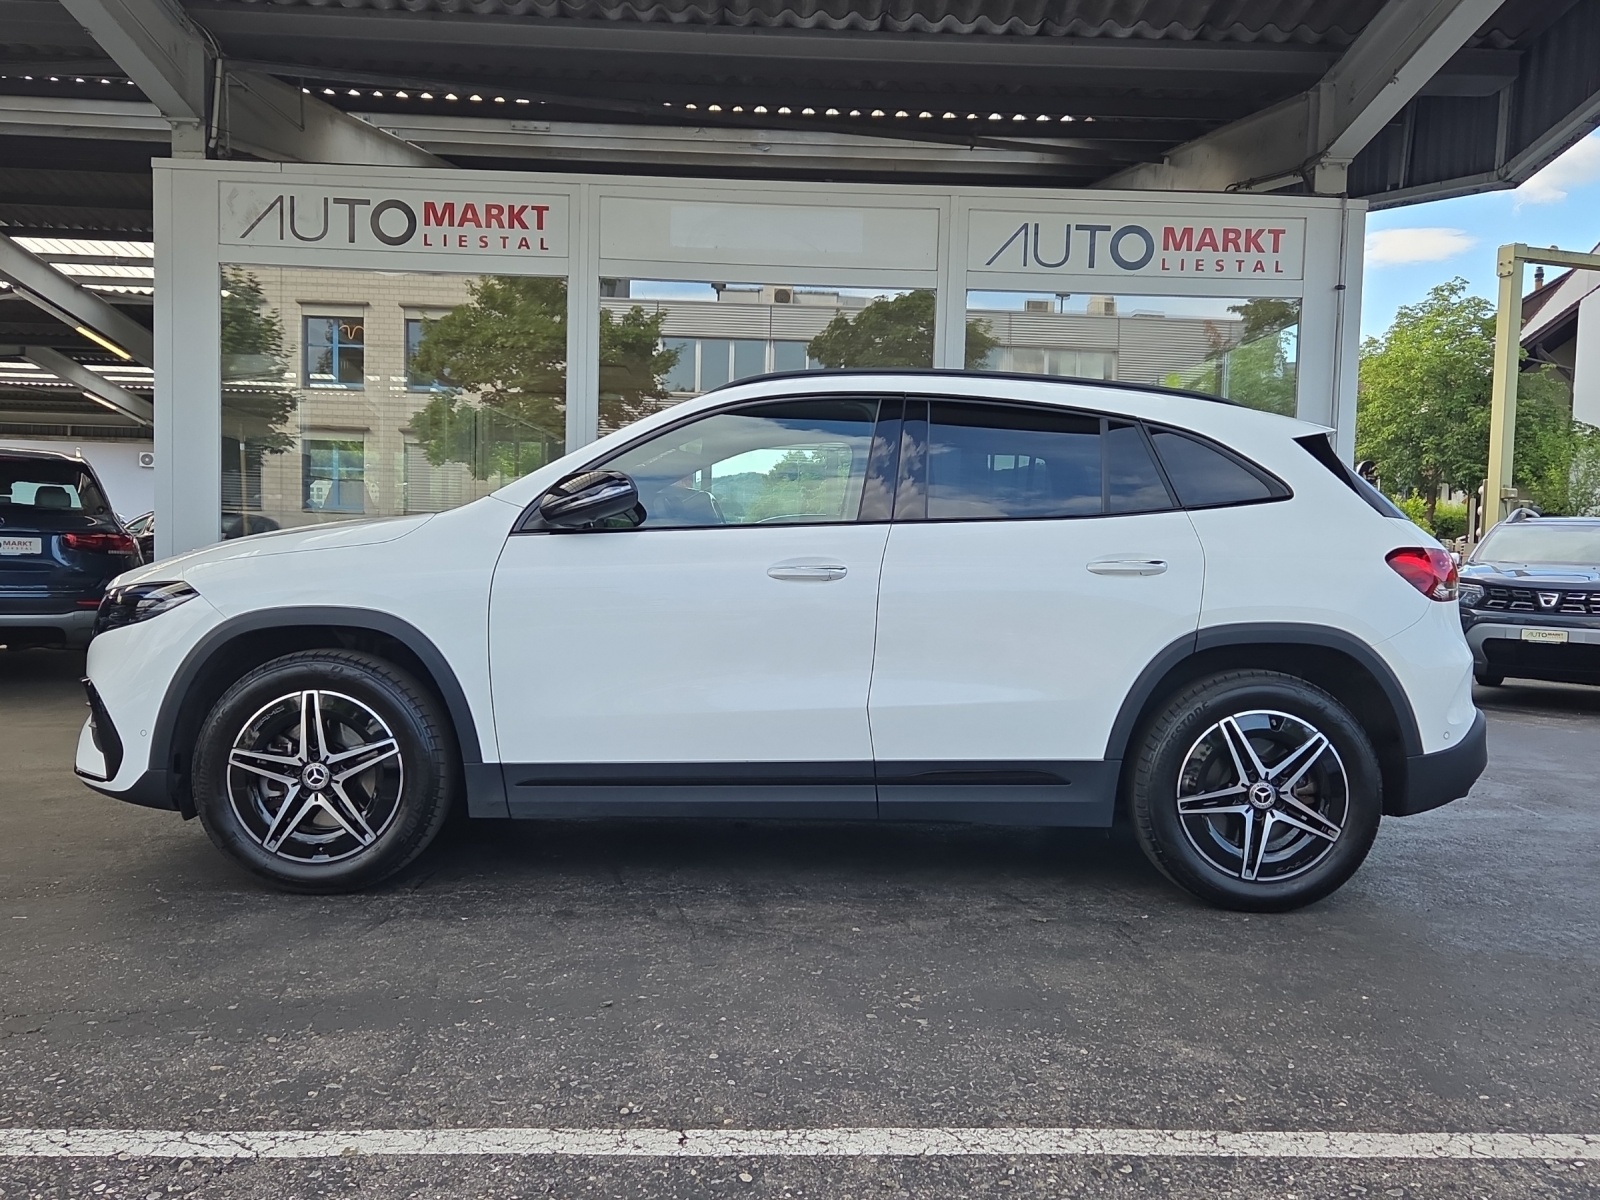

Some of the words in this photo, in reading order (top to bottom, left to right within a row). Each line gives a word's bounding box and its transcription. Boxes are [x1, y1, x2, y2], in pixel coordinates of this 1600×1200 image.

[240, 195, 417, 246] AUTO
[423, 201, 549, 230] MARKT
[423, 234, 549, 251] LIESTAL
[985, 222, 1155, 271] AUTO
[1162, 226, 1286, 253] MARKT
[1161, 257, 1284, 273] LIESTAL
